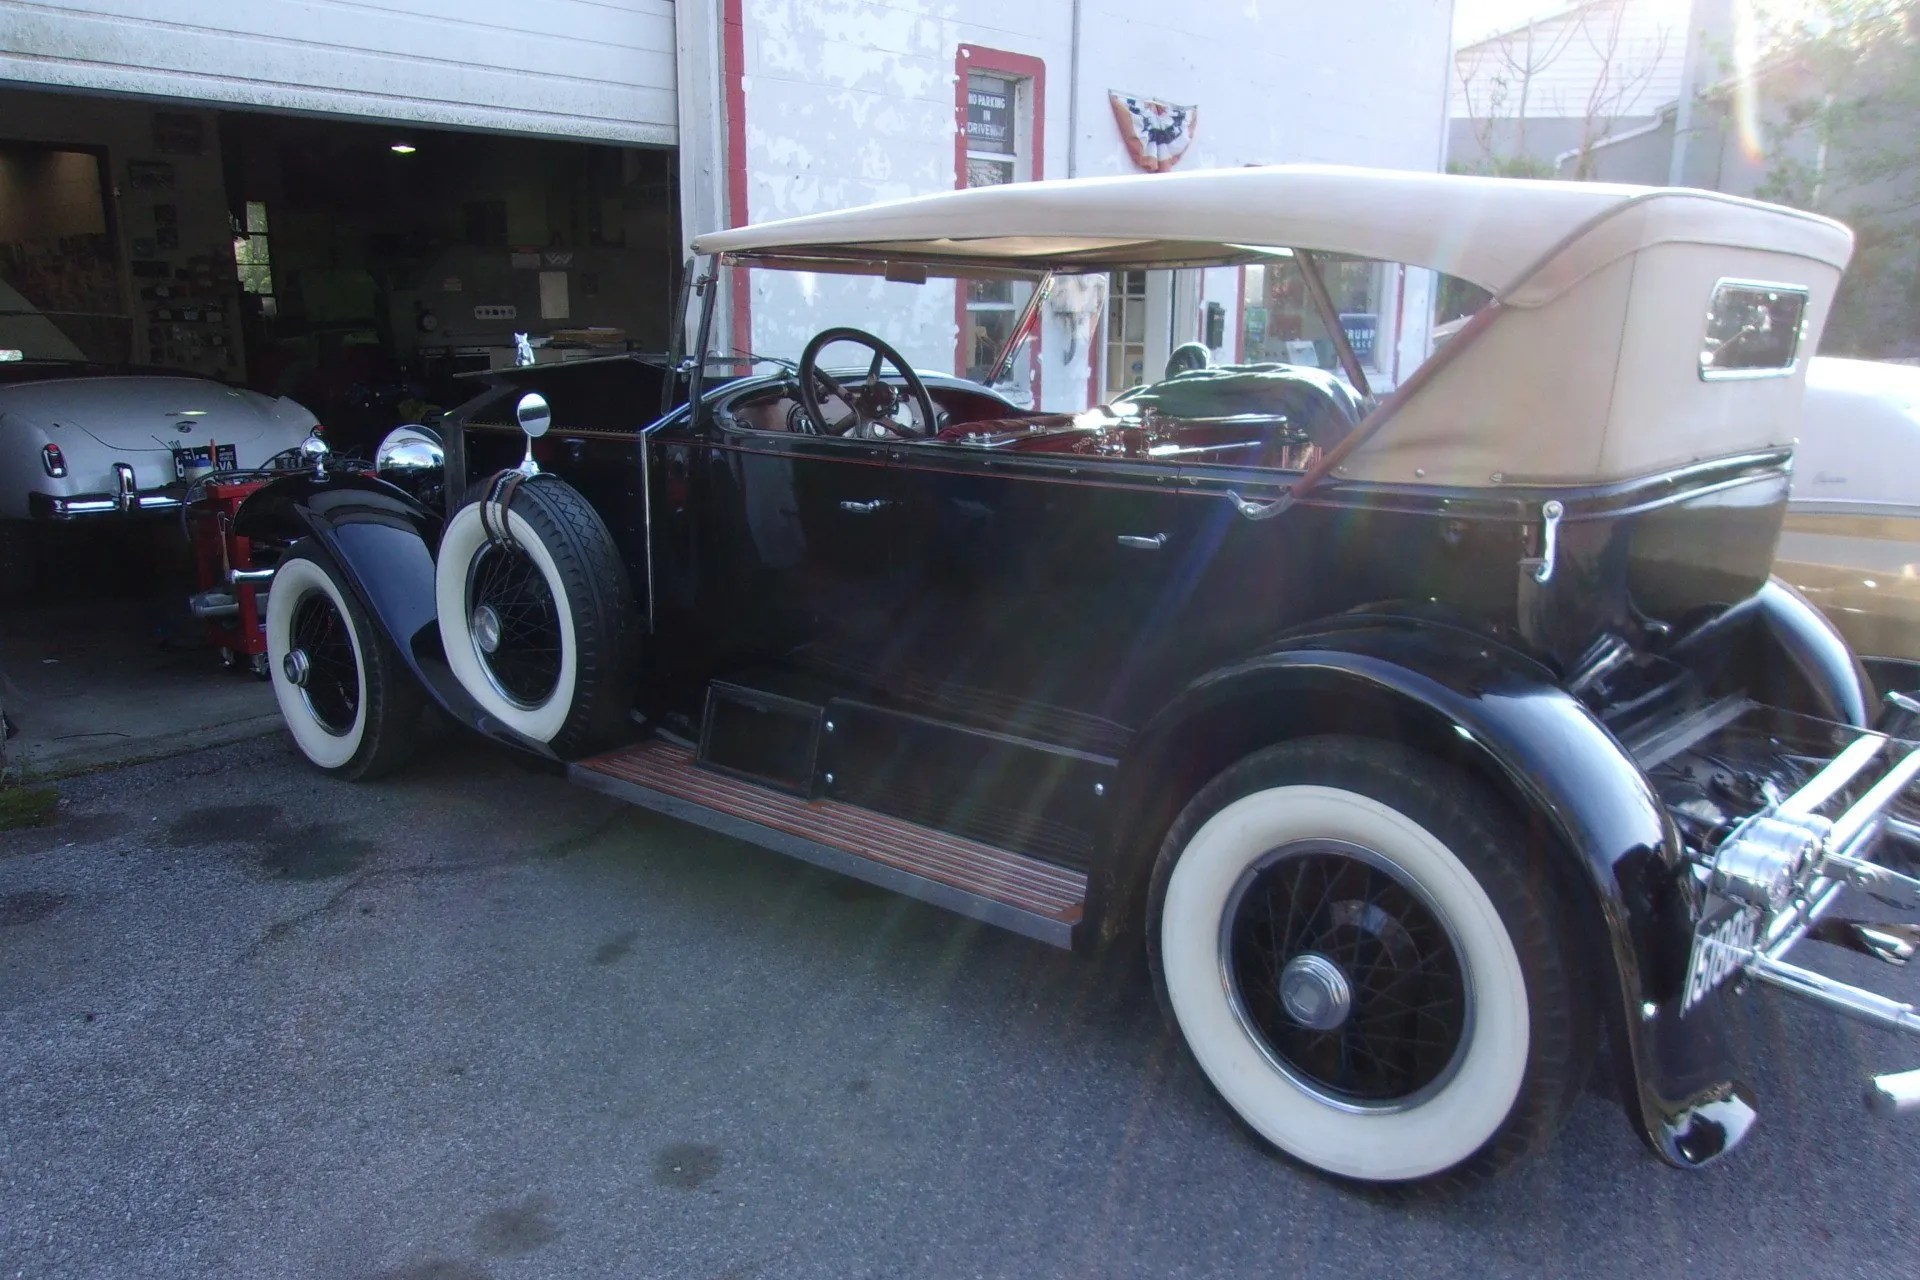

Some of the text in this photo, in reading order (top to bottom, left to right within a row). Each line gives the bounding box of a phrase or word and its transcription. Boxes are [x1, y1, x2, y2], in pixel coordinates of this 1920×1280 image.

[968, 92, 1005, 109] NO PARKING
[983, 110, 990, 121] IN
[968, 122, 1005, 137] DRIVEWAY
[219, 461, 233, 470] VA
